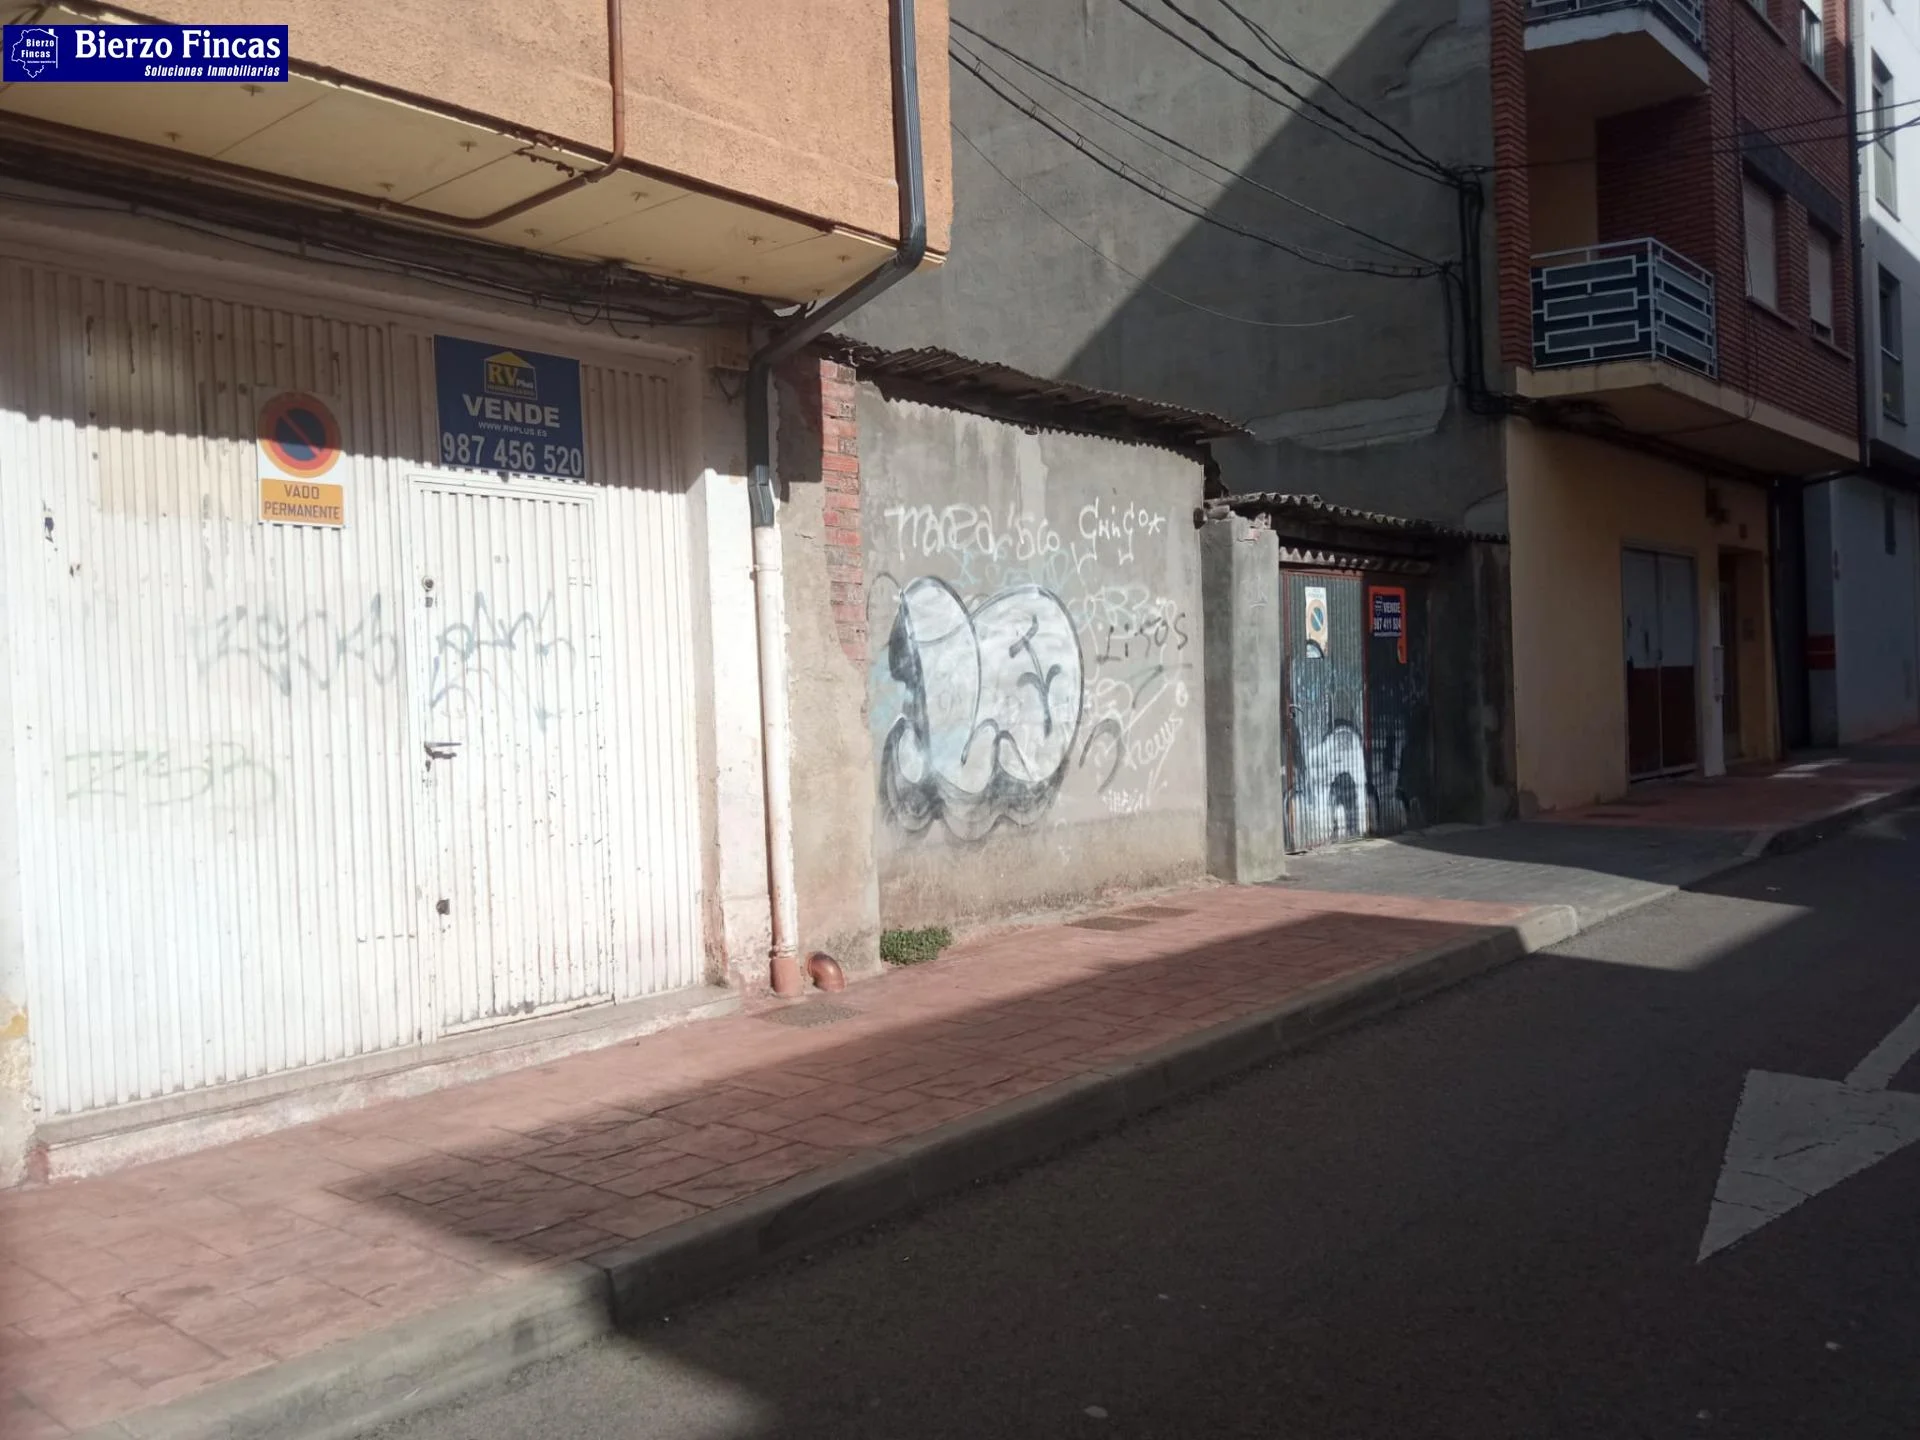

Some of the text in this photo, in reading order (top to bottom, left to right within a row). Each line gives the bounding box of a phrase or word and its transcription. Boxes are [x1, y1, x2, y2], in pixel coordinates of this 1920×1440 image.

[487, 362, 519, 387] RV
[462, 393, 561, 429] VENDE
[442, 432, 583, 477] 987 456 520
[283, 483, 321, 500] VADO
[263, 501, 341, 520] PERMANENTE
